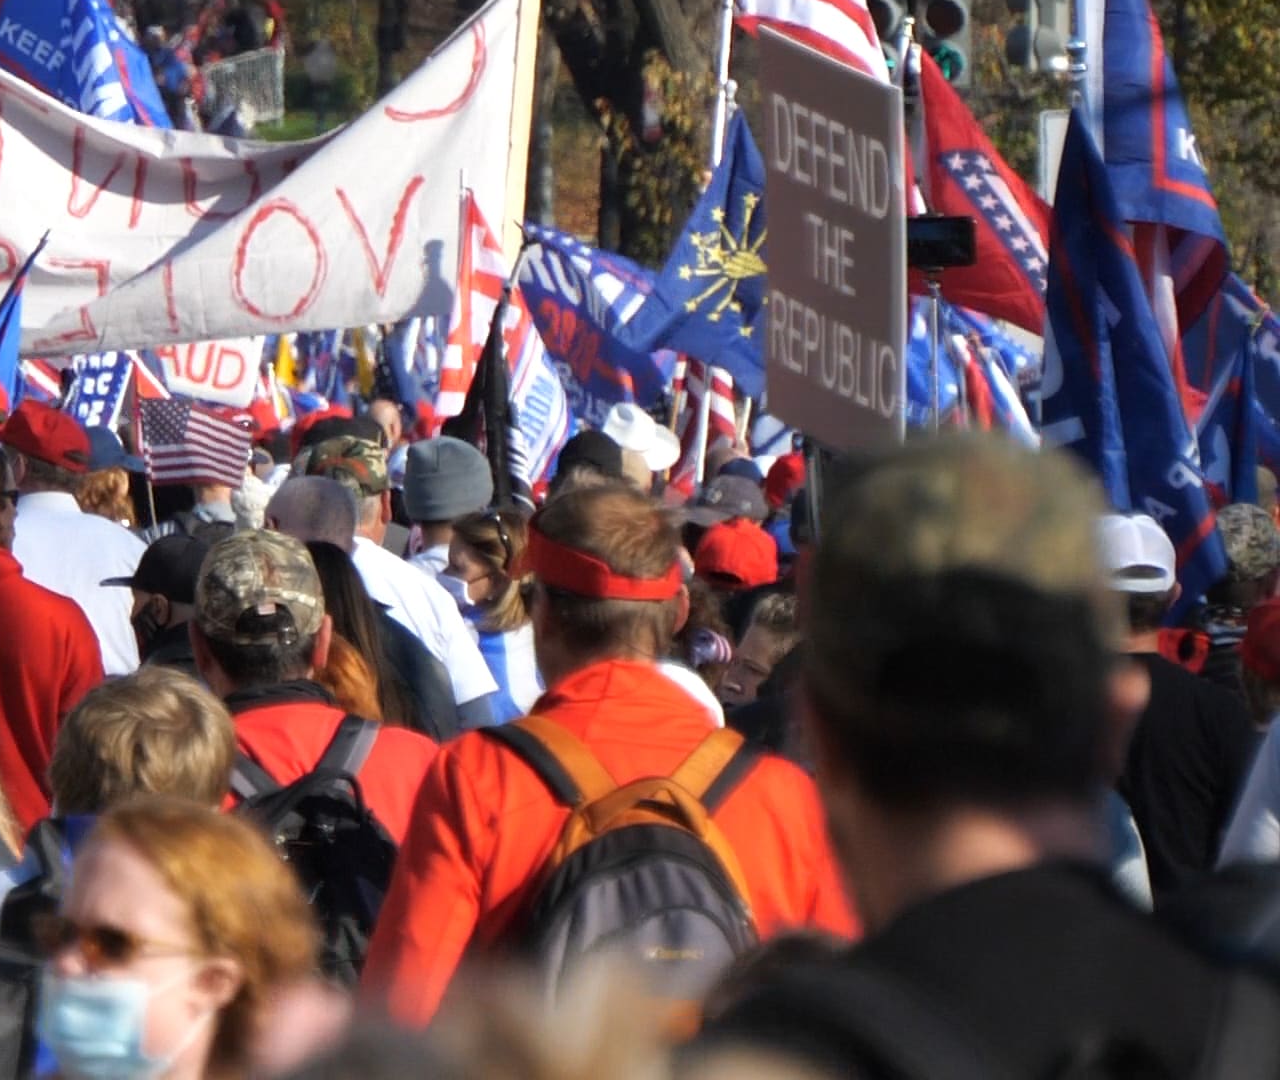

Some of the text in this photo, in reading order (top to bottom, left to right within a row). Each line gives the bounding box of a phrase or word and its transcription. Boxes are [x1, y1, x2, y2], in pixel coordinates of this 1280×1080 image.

[770, 92, 892, 220] DEFEND
[807, 212, 857, 298] THE
[770, 290, 899, 420] REPUBLIC
